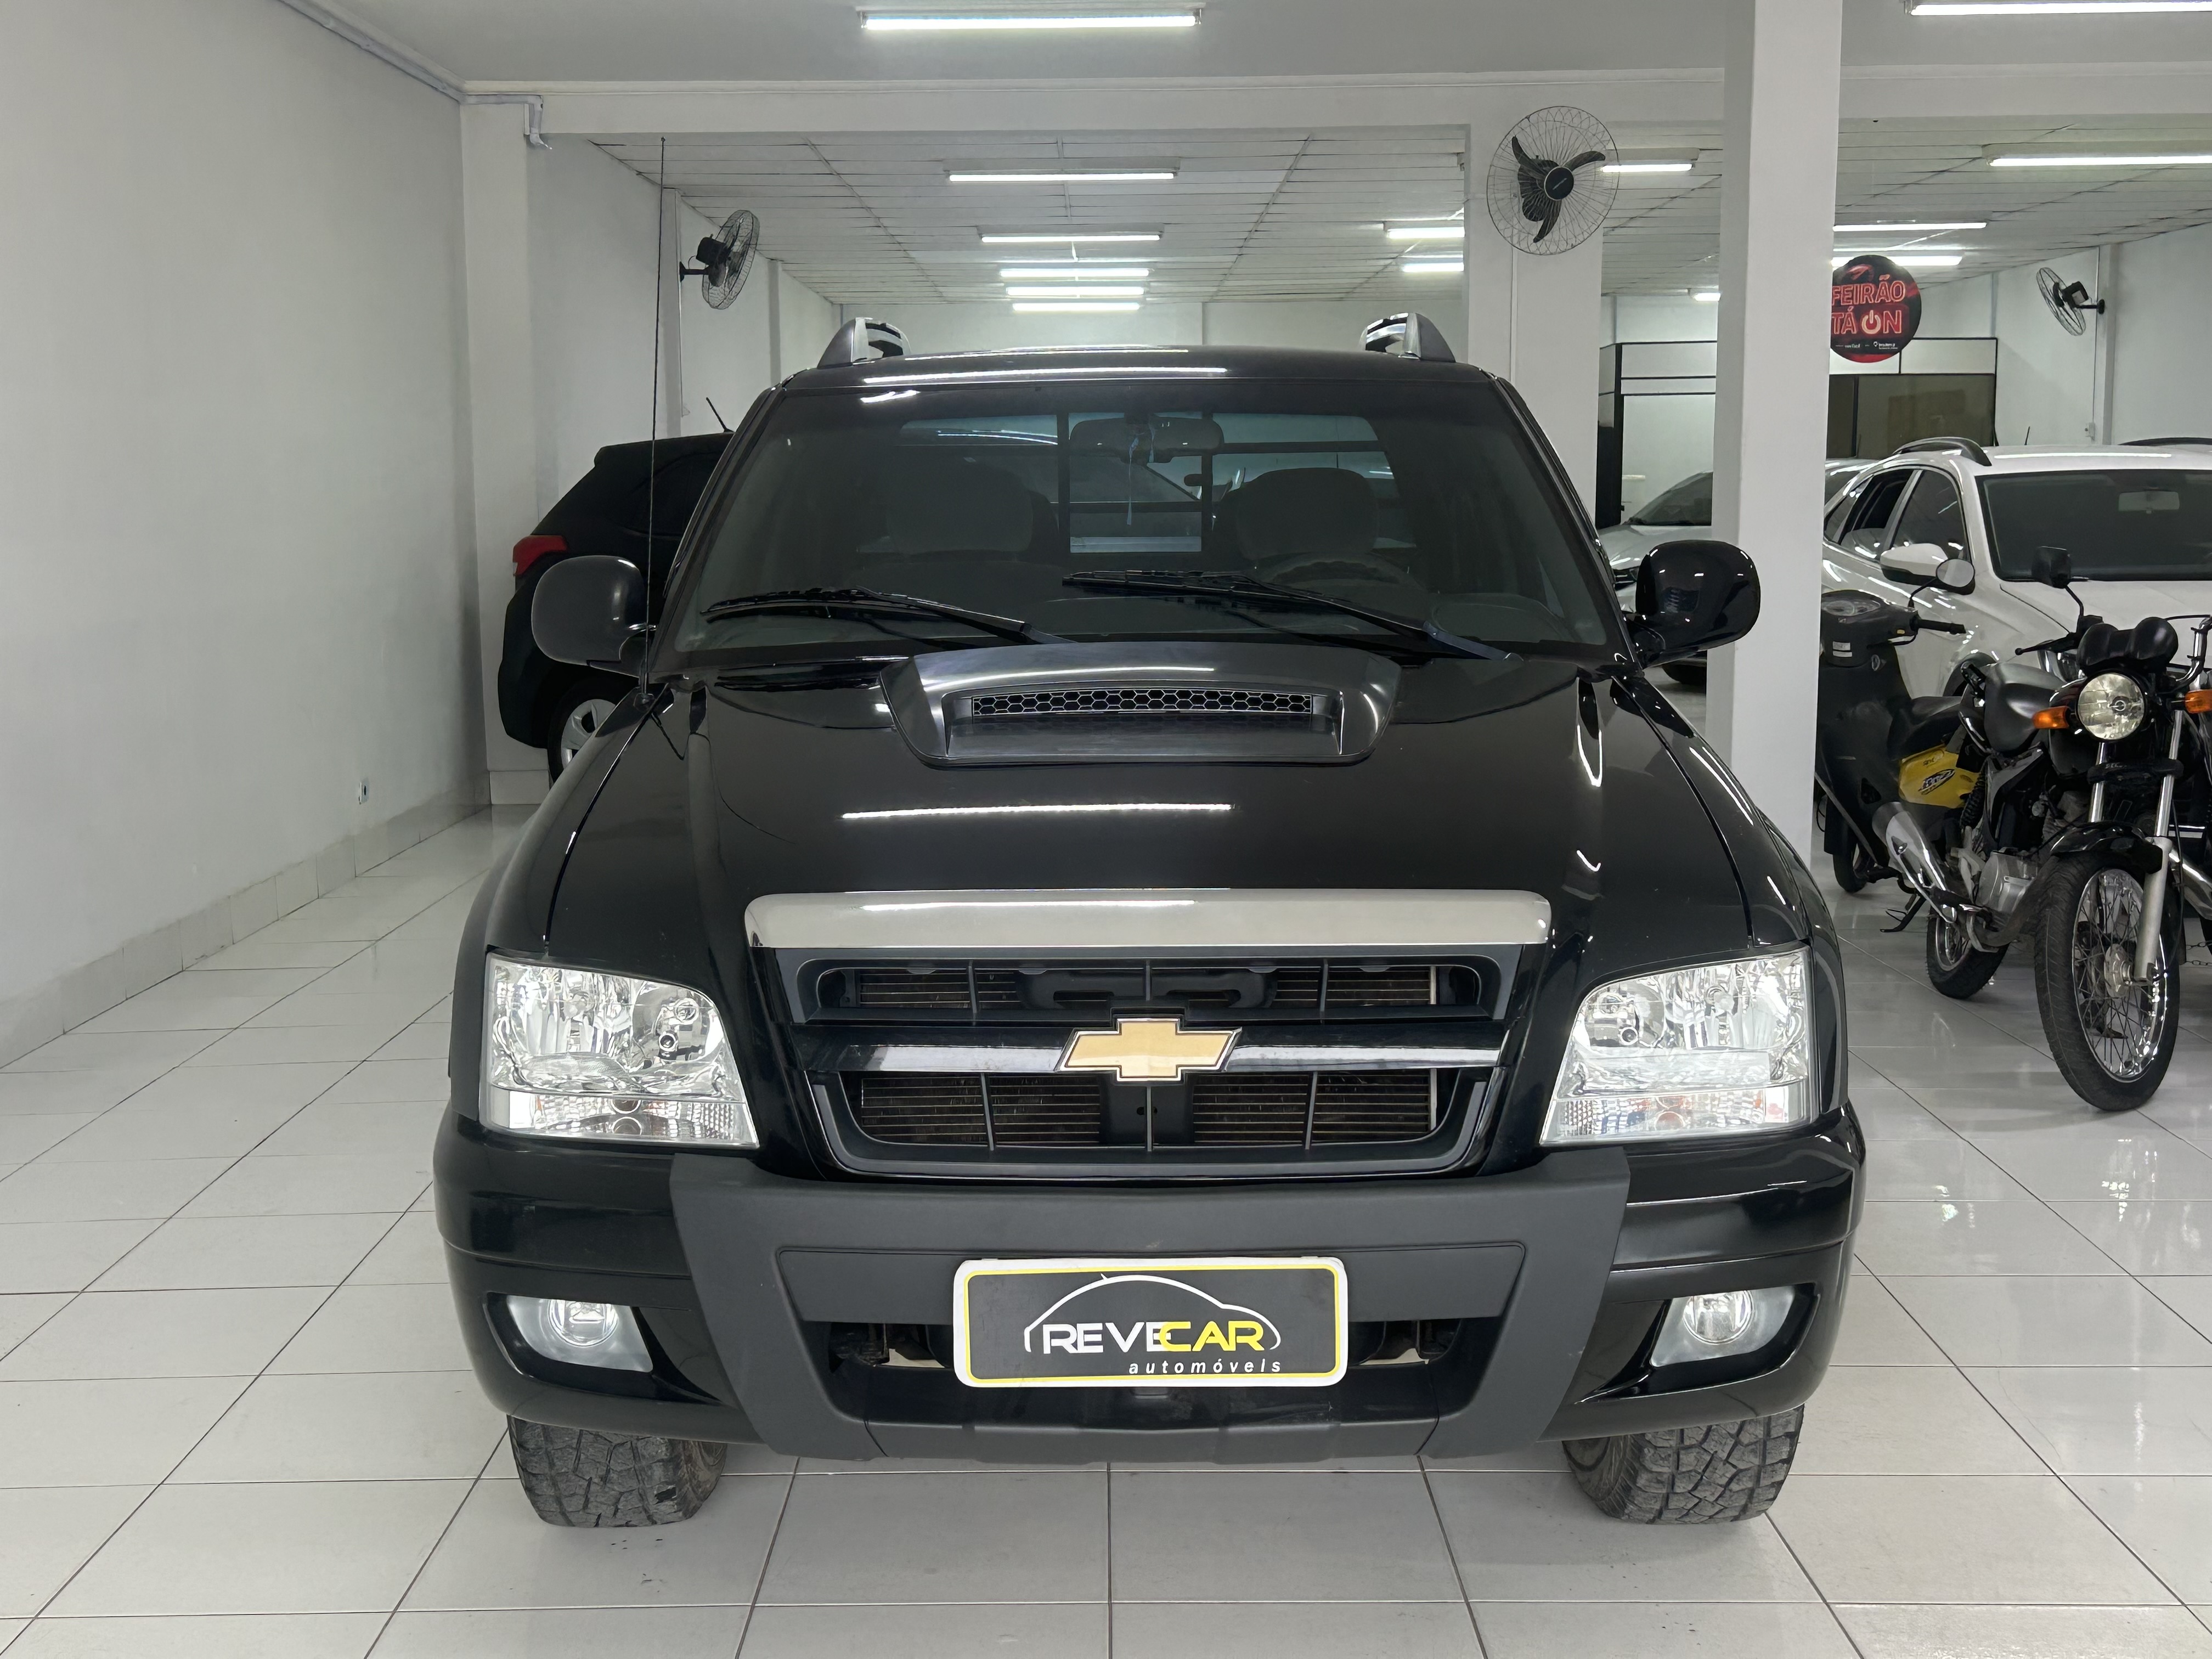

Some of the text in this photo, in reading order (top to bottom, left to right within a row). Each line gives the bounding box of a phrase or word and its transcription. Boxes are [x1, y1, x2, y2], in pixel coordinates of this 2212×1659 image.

[1832, 274, 1906, 306] FEIRÃO
[1831, 306, 1857, 334] TÁ
[1043, 1321, 1265, 1354] REVECAR
[1128, 1358, 1281, 1374] automóveis
